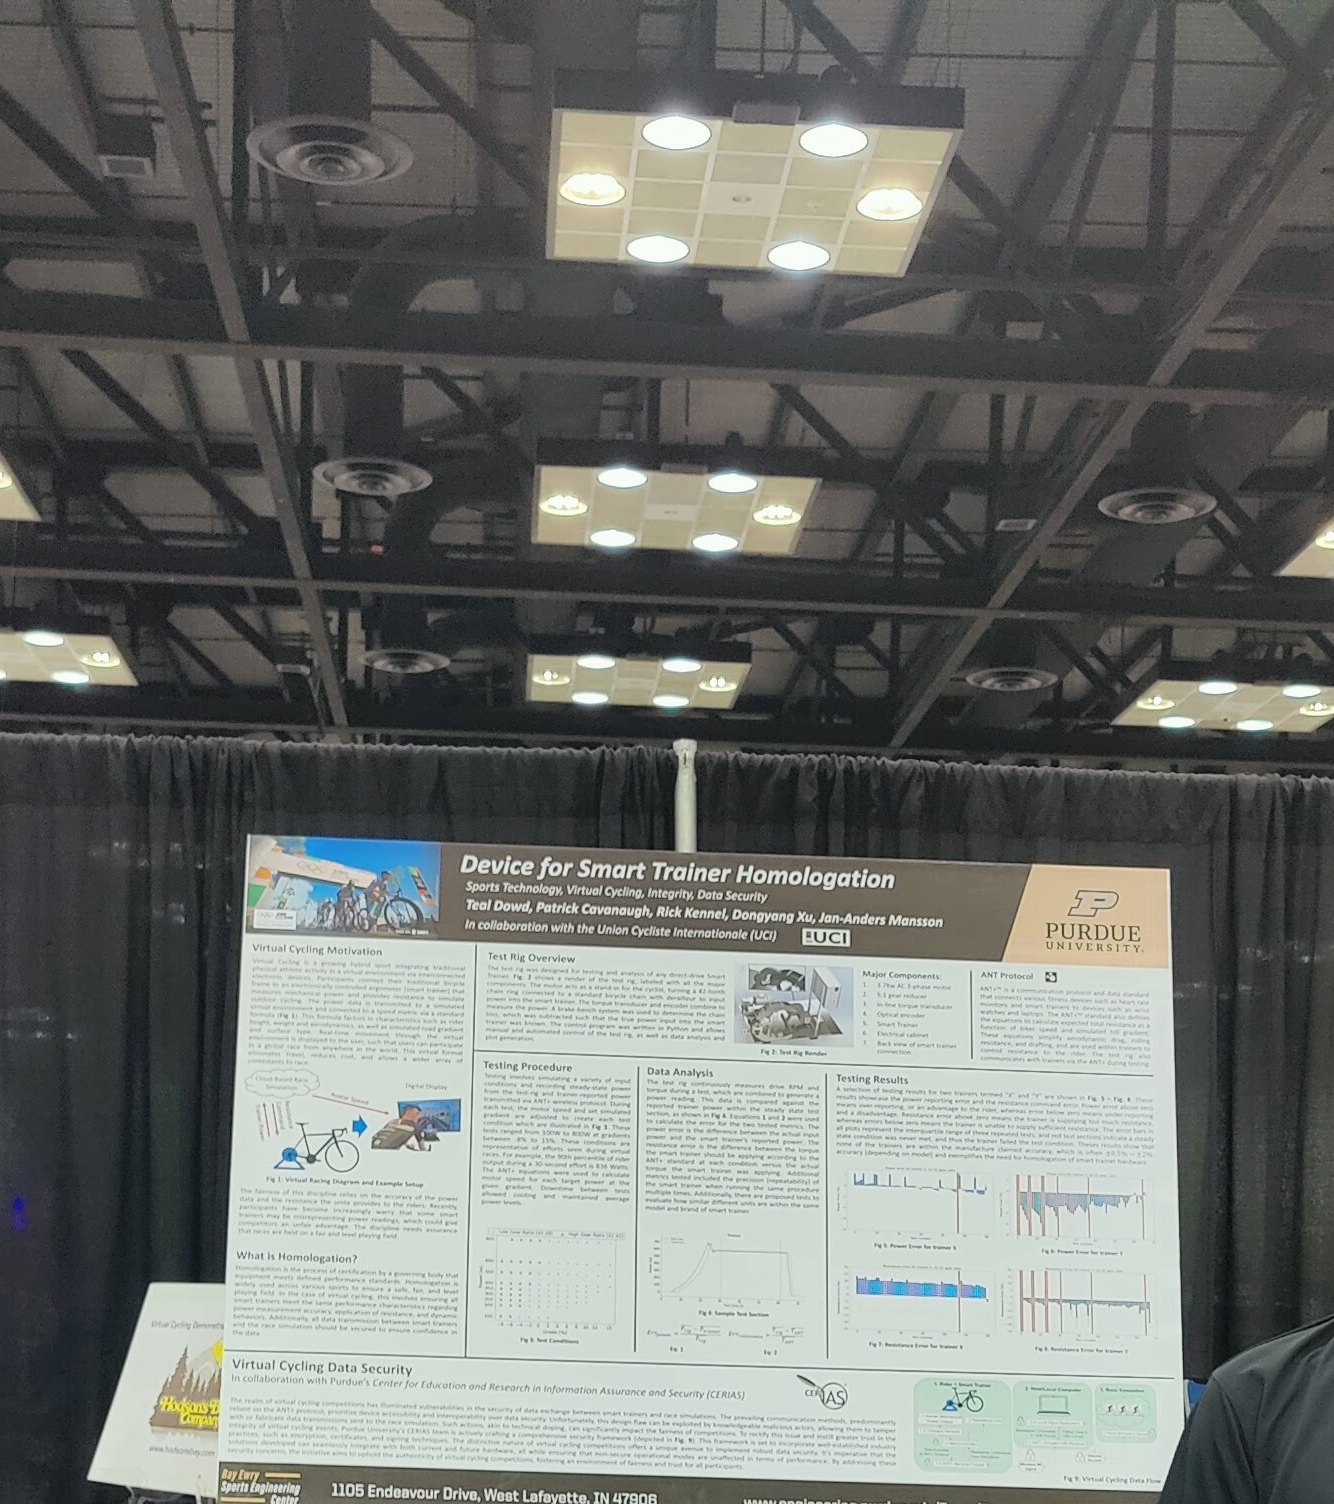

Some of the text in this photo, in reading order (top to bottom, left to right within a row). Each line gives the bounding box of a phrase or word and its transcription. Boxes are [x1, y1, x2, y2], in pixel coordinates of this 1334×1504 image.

[460, 854, 895, 891] Device for Smart Trainer Homologation
[466, 881, 768, 904] Sports Technology, Virtual Cycling, Integrity, Data Security
[466, 899, 944, 927] Teal Dowd, Patrick Cavanaugh, Rick Kennel, Dongyang Xu, Jan-Anders Mansson
[465, 919, 778, 943] In collaboration with the Union Cycliste Internationale (UCI)
[1045, 922, 1141, 942] PURDUE
[813, 932, 847, 944] UCI
[252, 943, 383, 956] Virtual Cycling Motivation
[488, 952, 575, 963] Test Rig Overview
[863, 971, 942, 980] Major Components:
[1000, 972, 1033, 980] Protocol
[484, 1061, 572, 1072] Testing Procedure
[647, 1067, 714, 1078] Data Analysis
[836, 1074, 909, 1085] Testing Results
[236, 1251, 357, 1264] What is Homologation?
[232, 1359, 413, 1377] Virtual Cycling Data Security
[242, 1375, 303, 1385] collaboration
[307, 1376, 327, 1385] with
[330, 1377, 370, 1386] Purdue's
[373, 1378, 402, 1388] Center
[404, 1380, 418, 1390] for
[421, 1380, 466, 1391] Education
[489, 1383, 530, 1393] Research
[533, 1384, 541, 1393] in
[543, 1385, 597, 1395] Information
[600, 1387, 645, 1397] Assurance
[649, 1388, 666, 1397] and
[668, 1389, 705, 1399] Security
[707, 1390, 745, 1400] (CERIAS)
[222, 1468, 260, 1481] Ray Ewry
[221, 1481, 301, 1495] Sports Engineering
[331, 1483, 364, 1497] 1105
[367, 1485, 440, 1500] Endeavour
[443, 1486, 481, 1503] Drive,
[484, 1488, 519, 1503] West
[593, 1492, 610, 1504] IN
